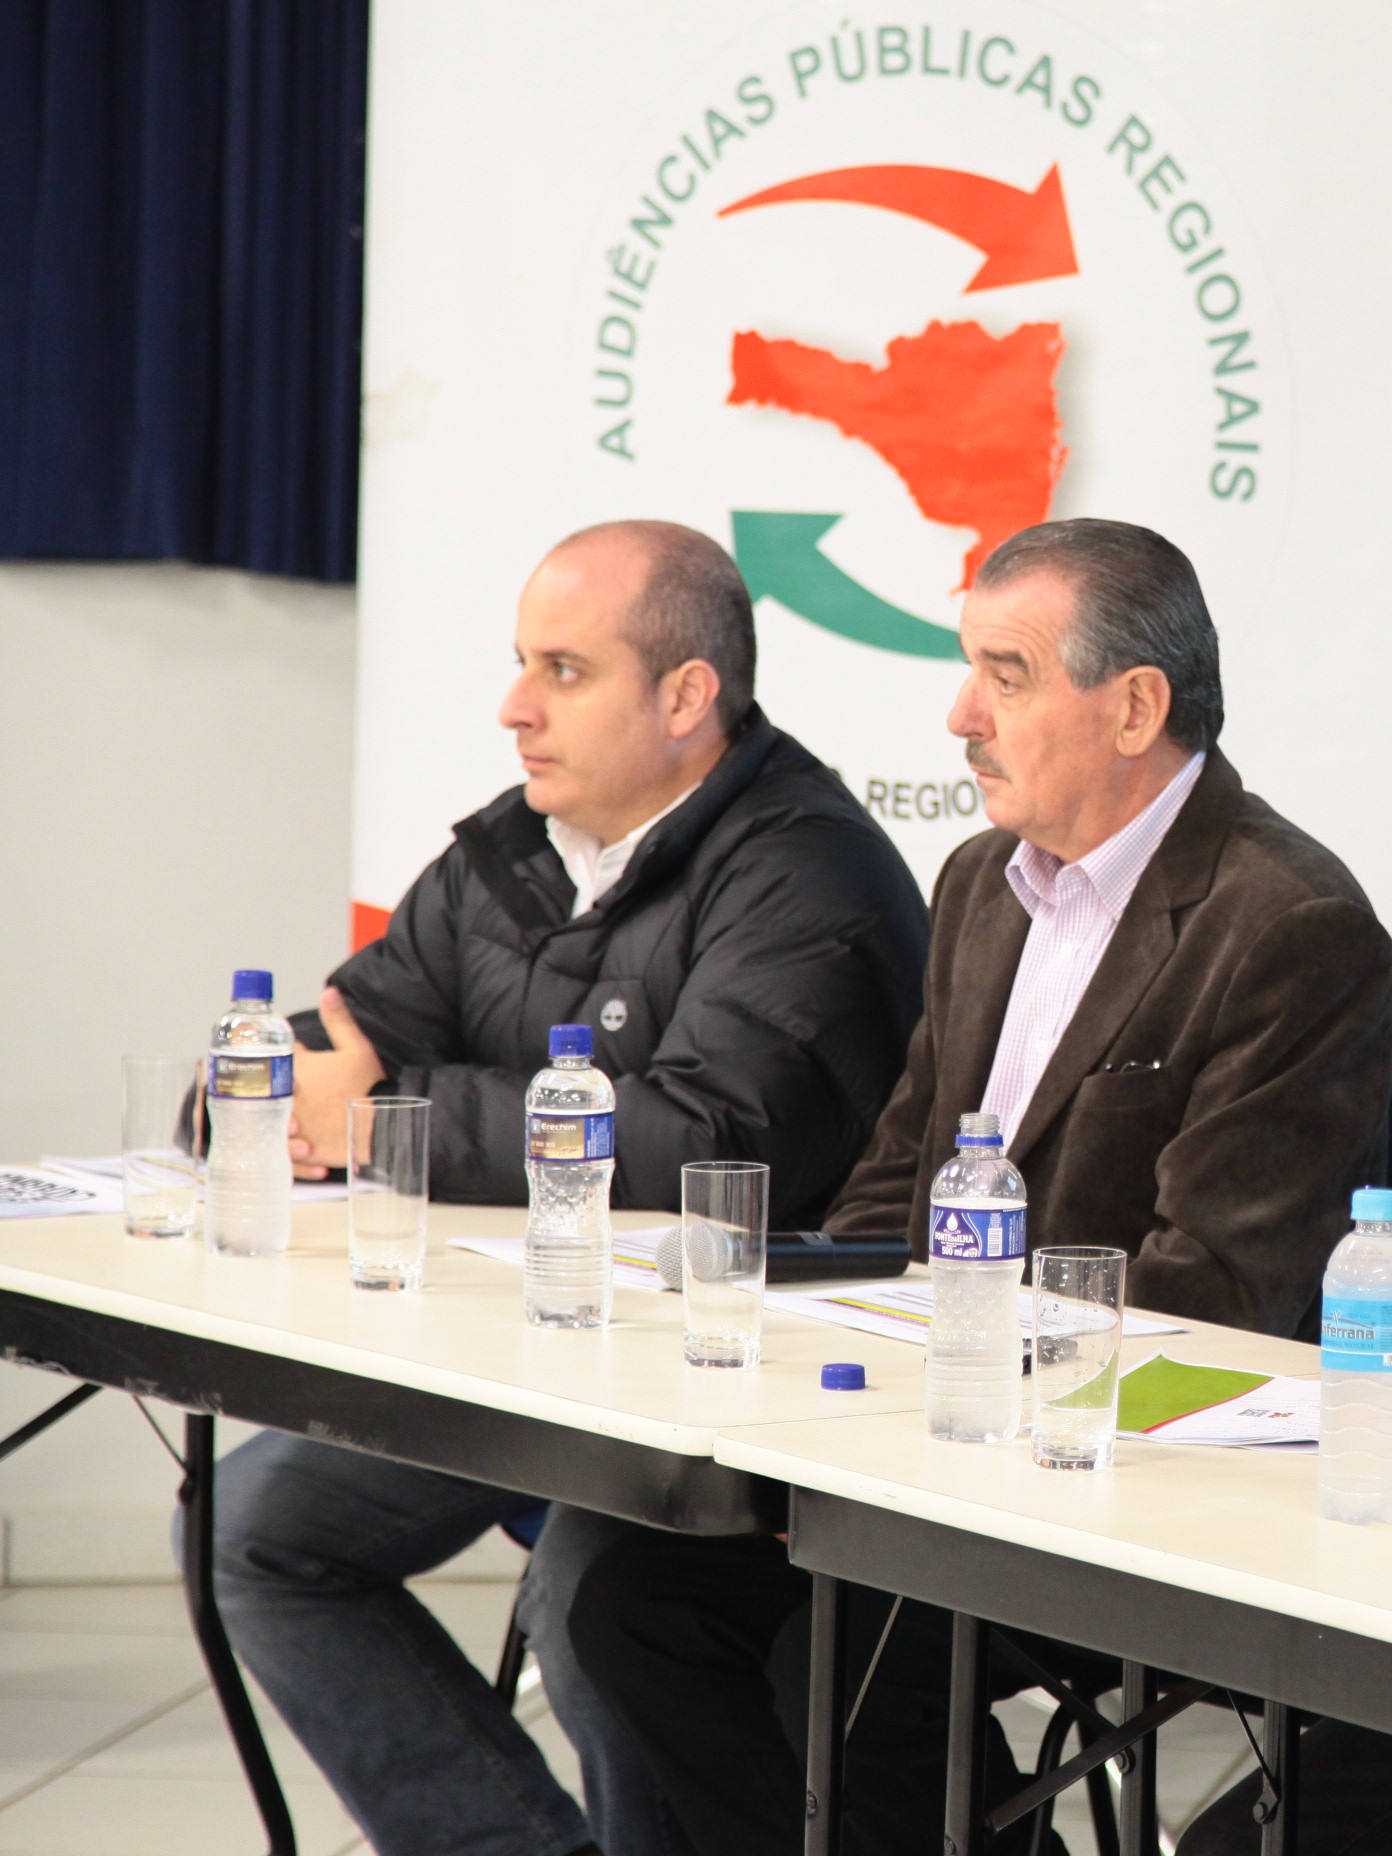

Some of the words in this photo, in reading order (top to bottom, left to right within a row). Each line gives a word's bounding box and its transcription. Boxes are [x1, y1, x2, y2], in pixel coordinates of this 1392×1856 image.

[593, 76, 777, 463] AUDIÊNCIAS
[787, 20, 1102, 128] PÚBLICAS
[1106, 114, 1261, 504] REGIONAIS
[866, 777, 986, 820] REGIO
[541, 1122, 577, 1131] Erechim
[941, 1246, 953, 1256] 500
